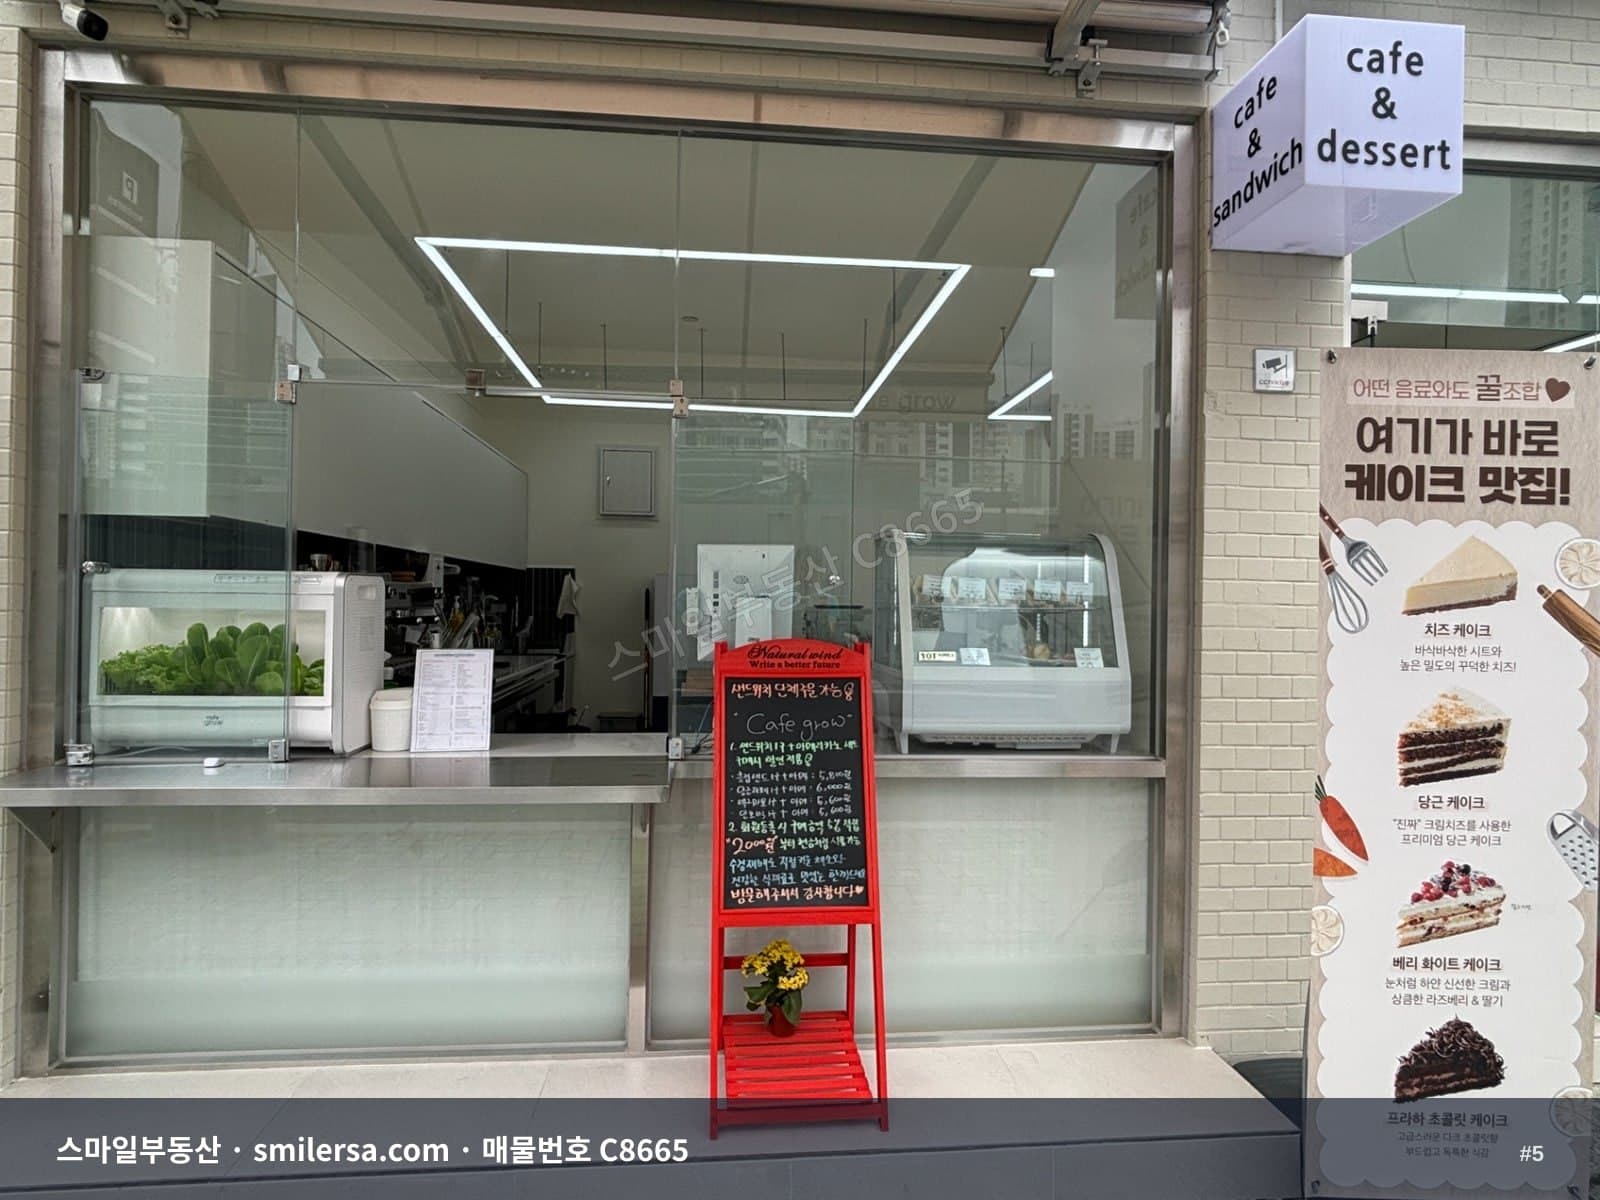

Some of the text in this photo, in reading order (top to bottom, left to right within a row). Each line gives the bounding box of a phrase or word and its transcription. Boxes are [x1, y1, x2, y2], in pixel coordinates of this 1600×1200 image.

[1346, 40, 1424, 76] cafe
[1234, 76, 1277, 129] cafe
[1372, 87, 1397, 119] &
[1247, 128, 1262, 158] &
[1317, 128, 1451, 170] dessert
[1213, 138, 1303, 227] sandwich
[1353, 374, 1542, 401] 어떤 음료와도 꿀조합
[1356, 416, 1559, 457] 여기가 바로
[1345, 463, 1570, 505] 케이크 맛집!
[1424, 623, 1491, 638] 치즈 케이크
[748, 645, 844, 659] Natural wind
[1415, 645, 1502, 658] 바삭바삭한 시트와
[1400, 659, 1516, 672] 높은 밀도의 꾸덕한 치즈!
[1418, 795, 1485, 810] 당근 케이크
[1424, 819, 1476, 832] 크림치즈를
[1479, 820, 1511, 832] 사용한
[1400, 834, 1502, 847] 프리미엄 당근 케이크
[1392, 956, 1501, 972] 베리 화이트 케이크
[1385, 977, 1511, 991] 눈처럼 하얀 신선한 크림과
[1391, 994, 1504, 1008] 상큼한 라즈베리 & 딸기
[1387, 1112, 1508, 1128] 프라하 초콜릿 케이크
